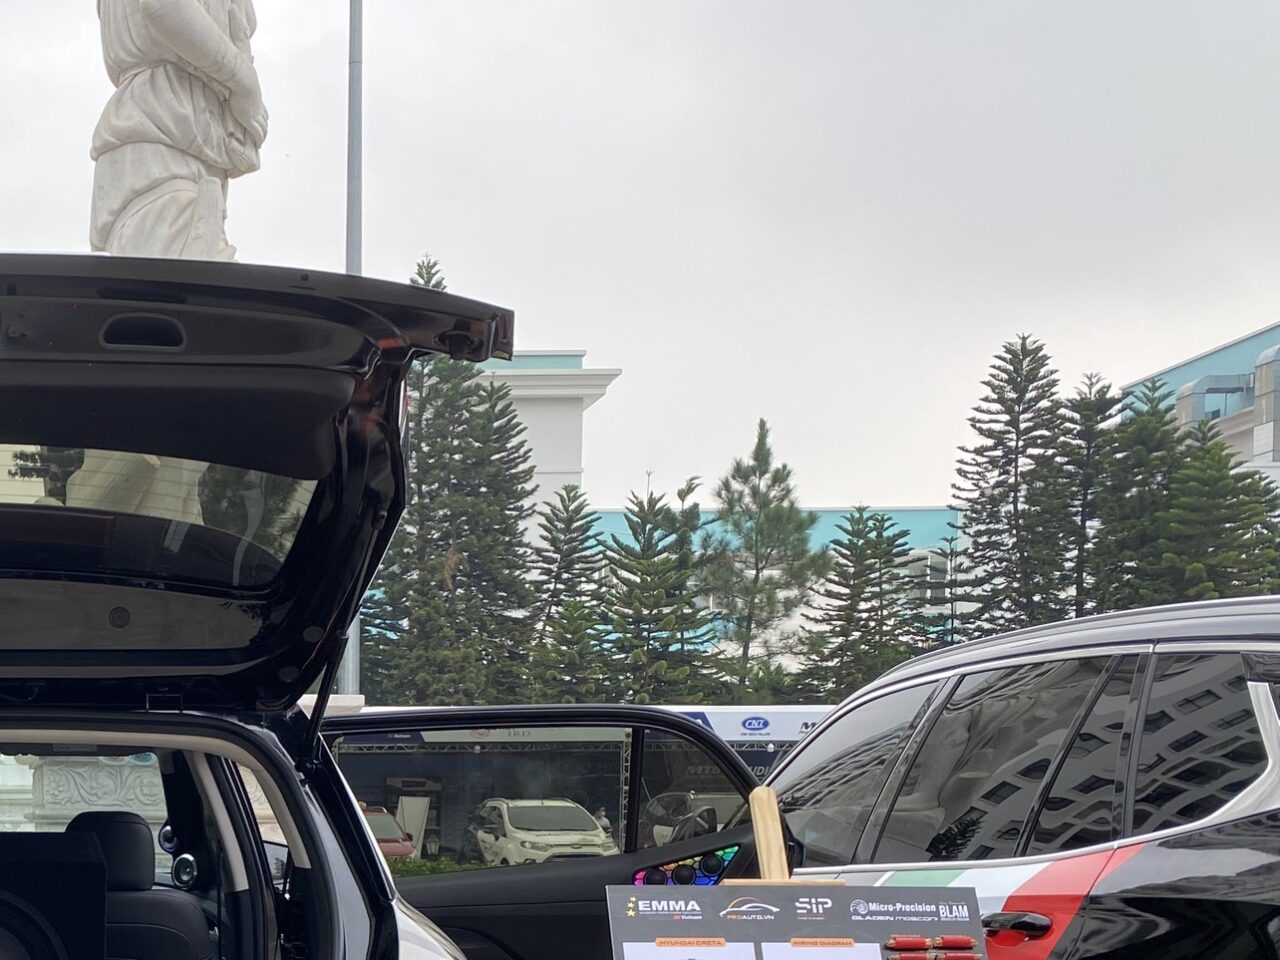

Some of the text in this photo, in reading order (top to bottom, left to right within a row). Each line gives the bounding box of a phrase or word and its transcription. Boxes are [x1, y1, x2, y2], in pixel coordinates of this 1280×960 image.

[638, 900, 702, 911] EMMA
[868, 902, 937, 912] Micro-Precision
[939, 904, 970, 918] BLAM
